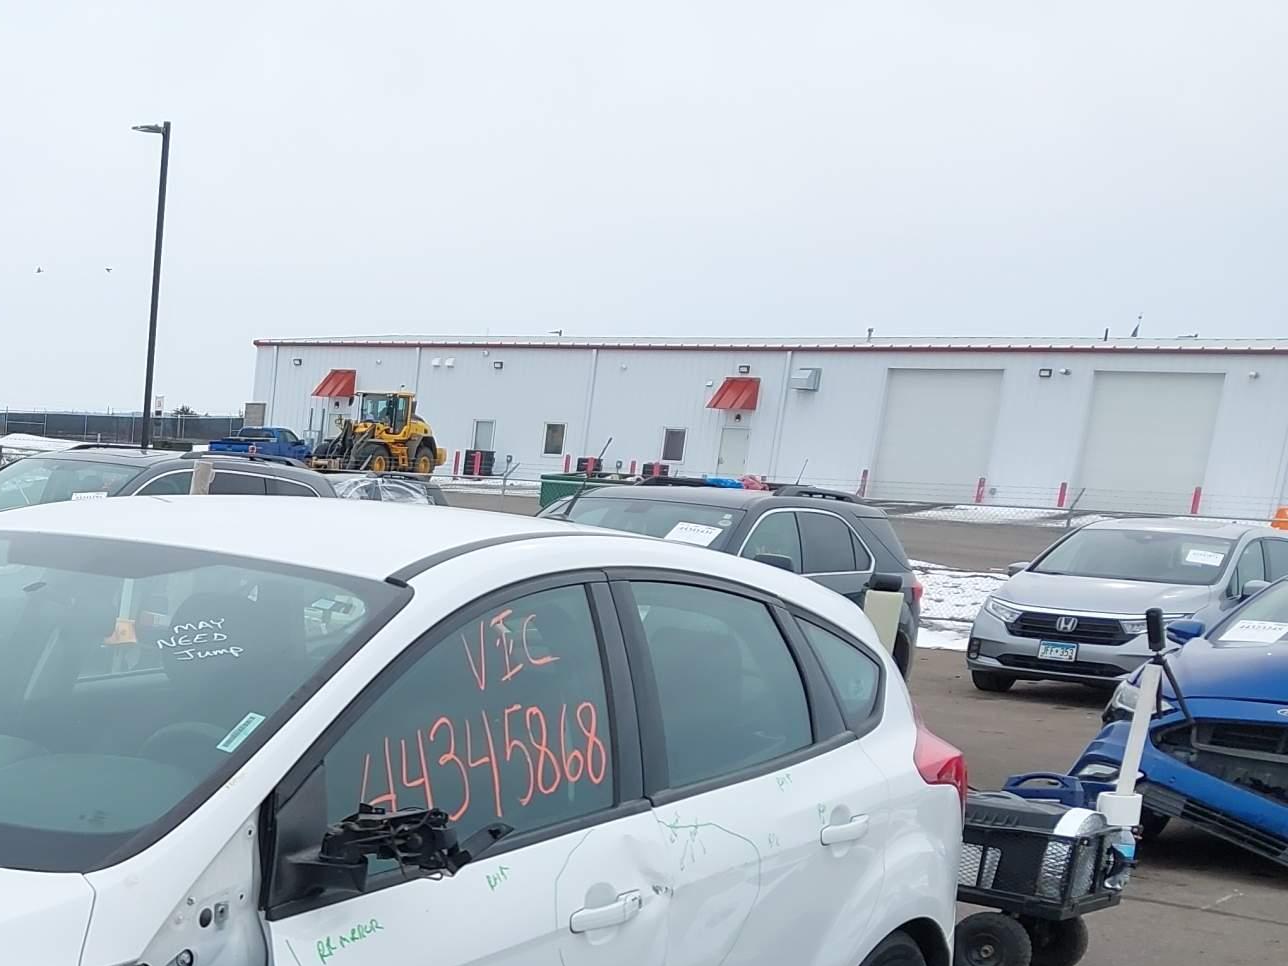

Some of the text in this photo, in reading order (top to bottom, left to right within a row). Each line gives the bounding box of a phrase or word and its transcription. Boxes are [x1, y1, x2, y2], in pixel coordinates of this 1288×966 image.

[173, 617, 225, 634] MAY
[156, 632, 227, 649] NEED
[360, 701, 608, 822] 44345868
